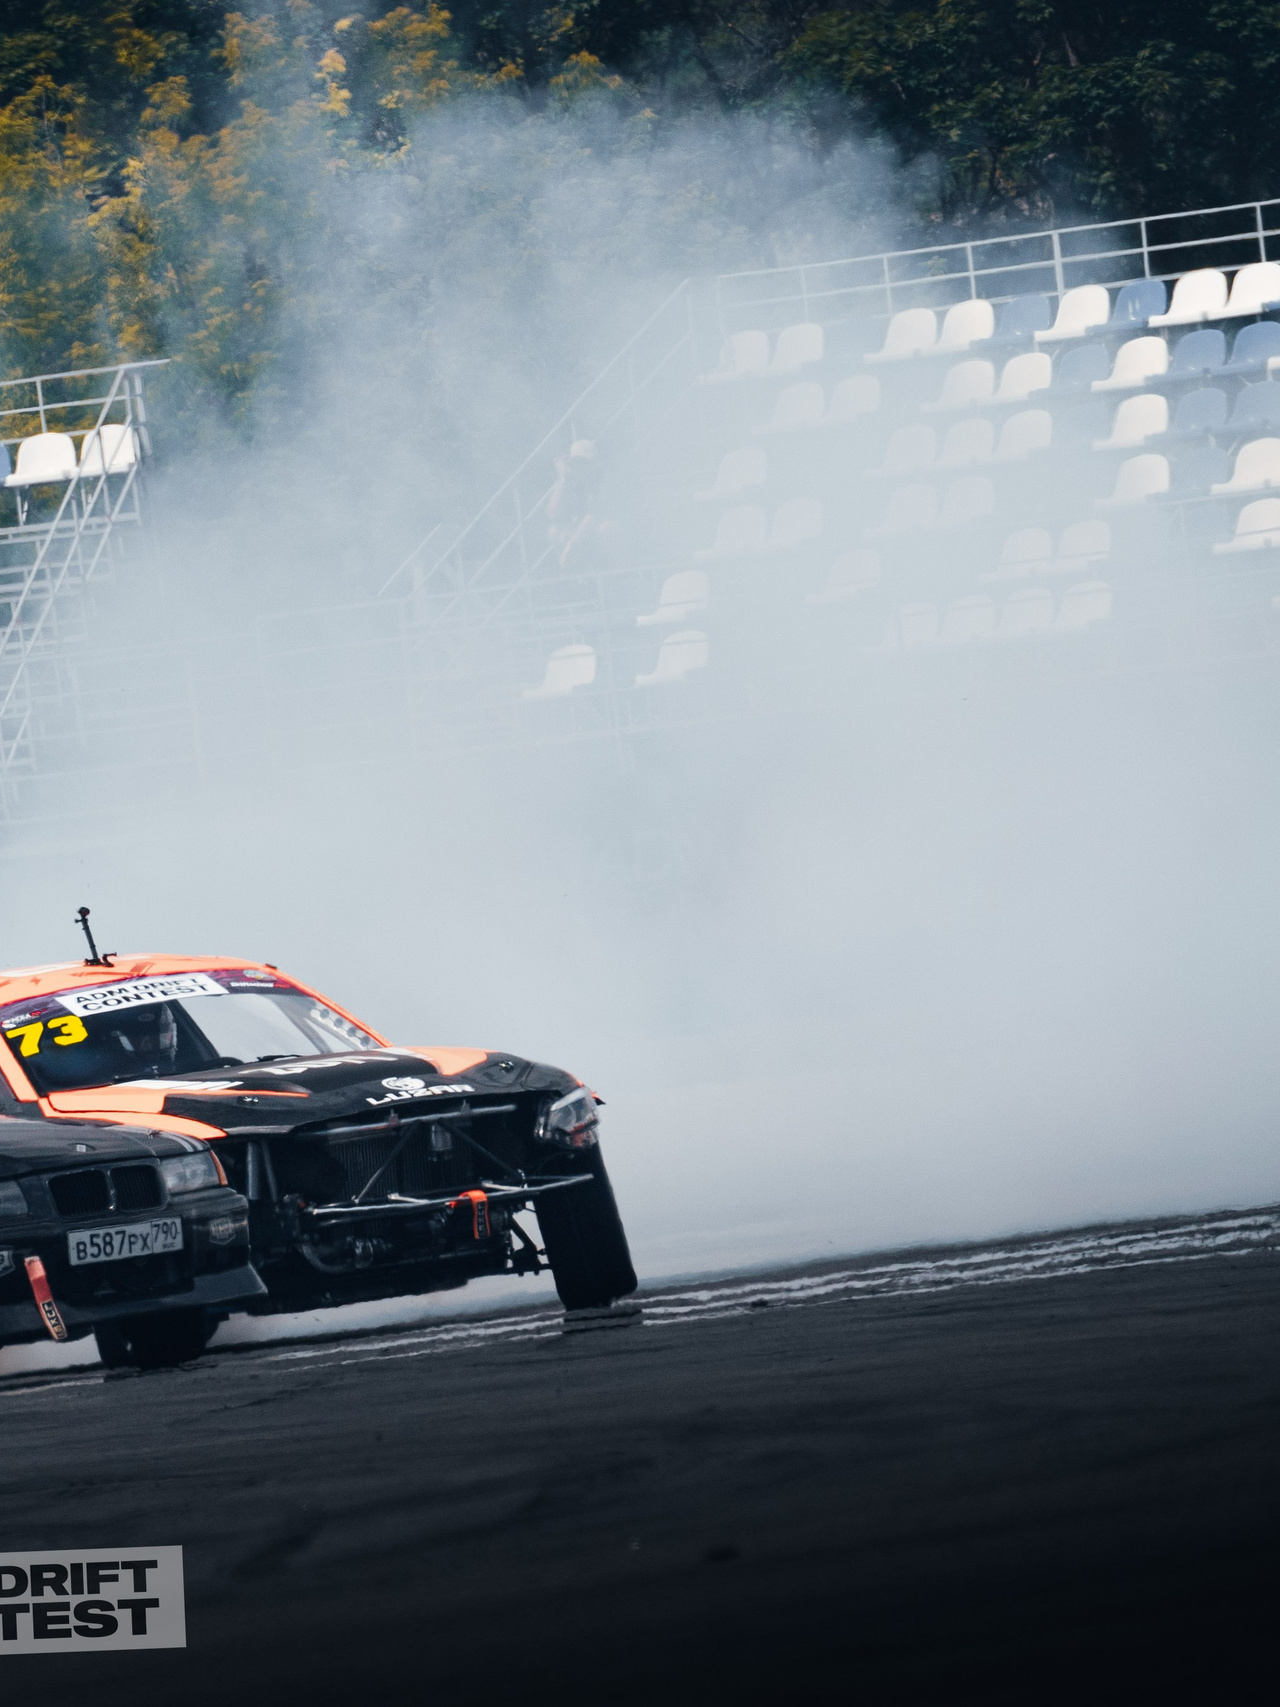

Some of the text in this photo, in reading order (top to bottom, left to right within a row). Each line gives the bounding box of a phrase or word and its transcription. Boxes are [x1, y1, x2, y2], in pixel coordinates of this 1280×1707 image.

[75, 977, 198, 1004] ADM DRIFT
[82, 984, 209, 1011] CONTEST
[5, 1015, 88, 1058] 73
[366, 1083, 475, 1105] LUZAR
